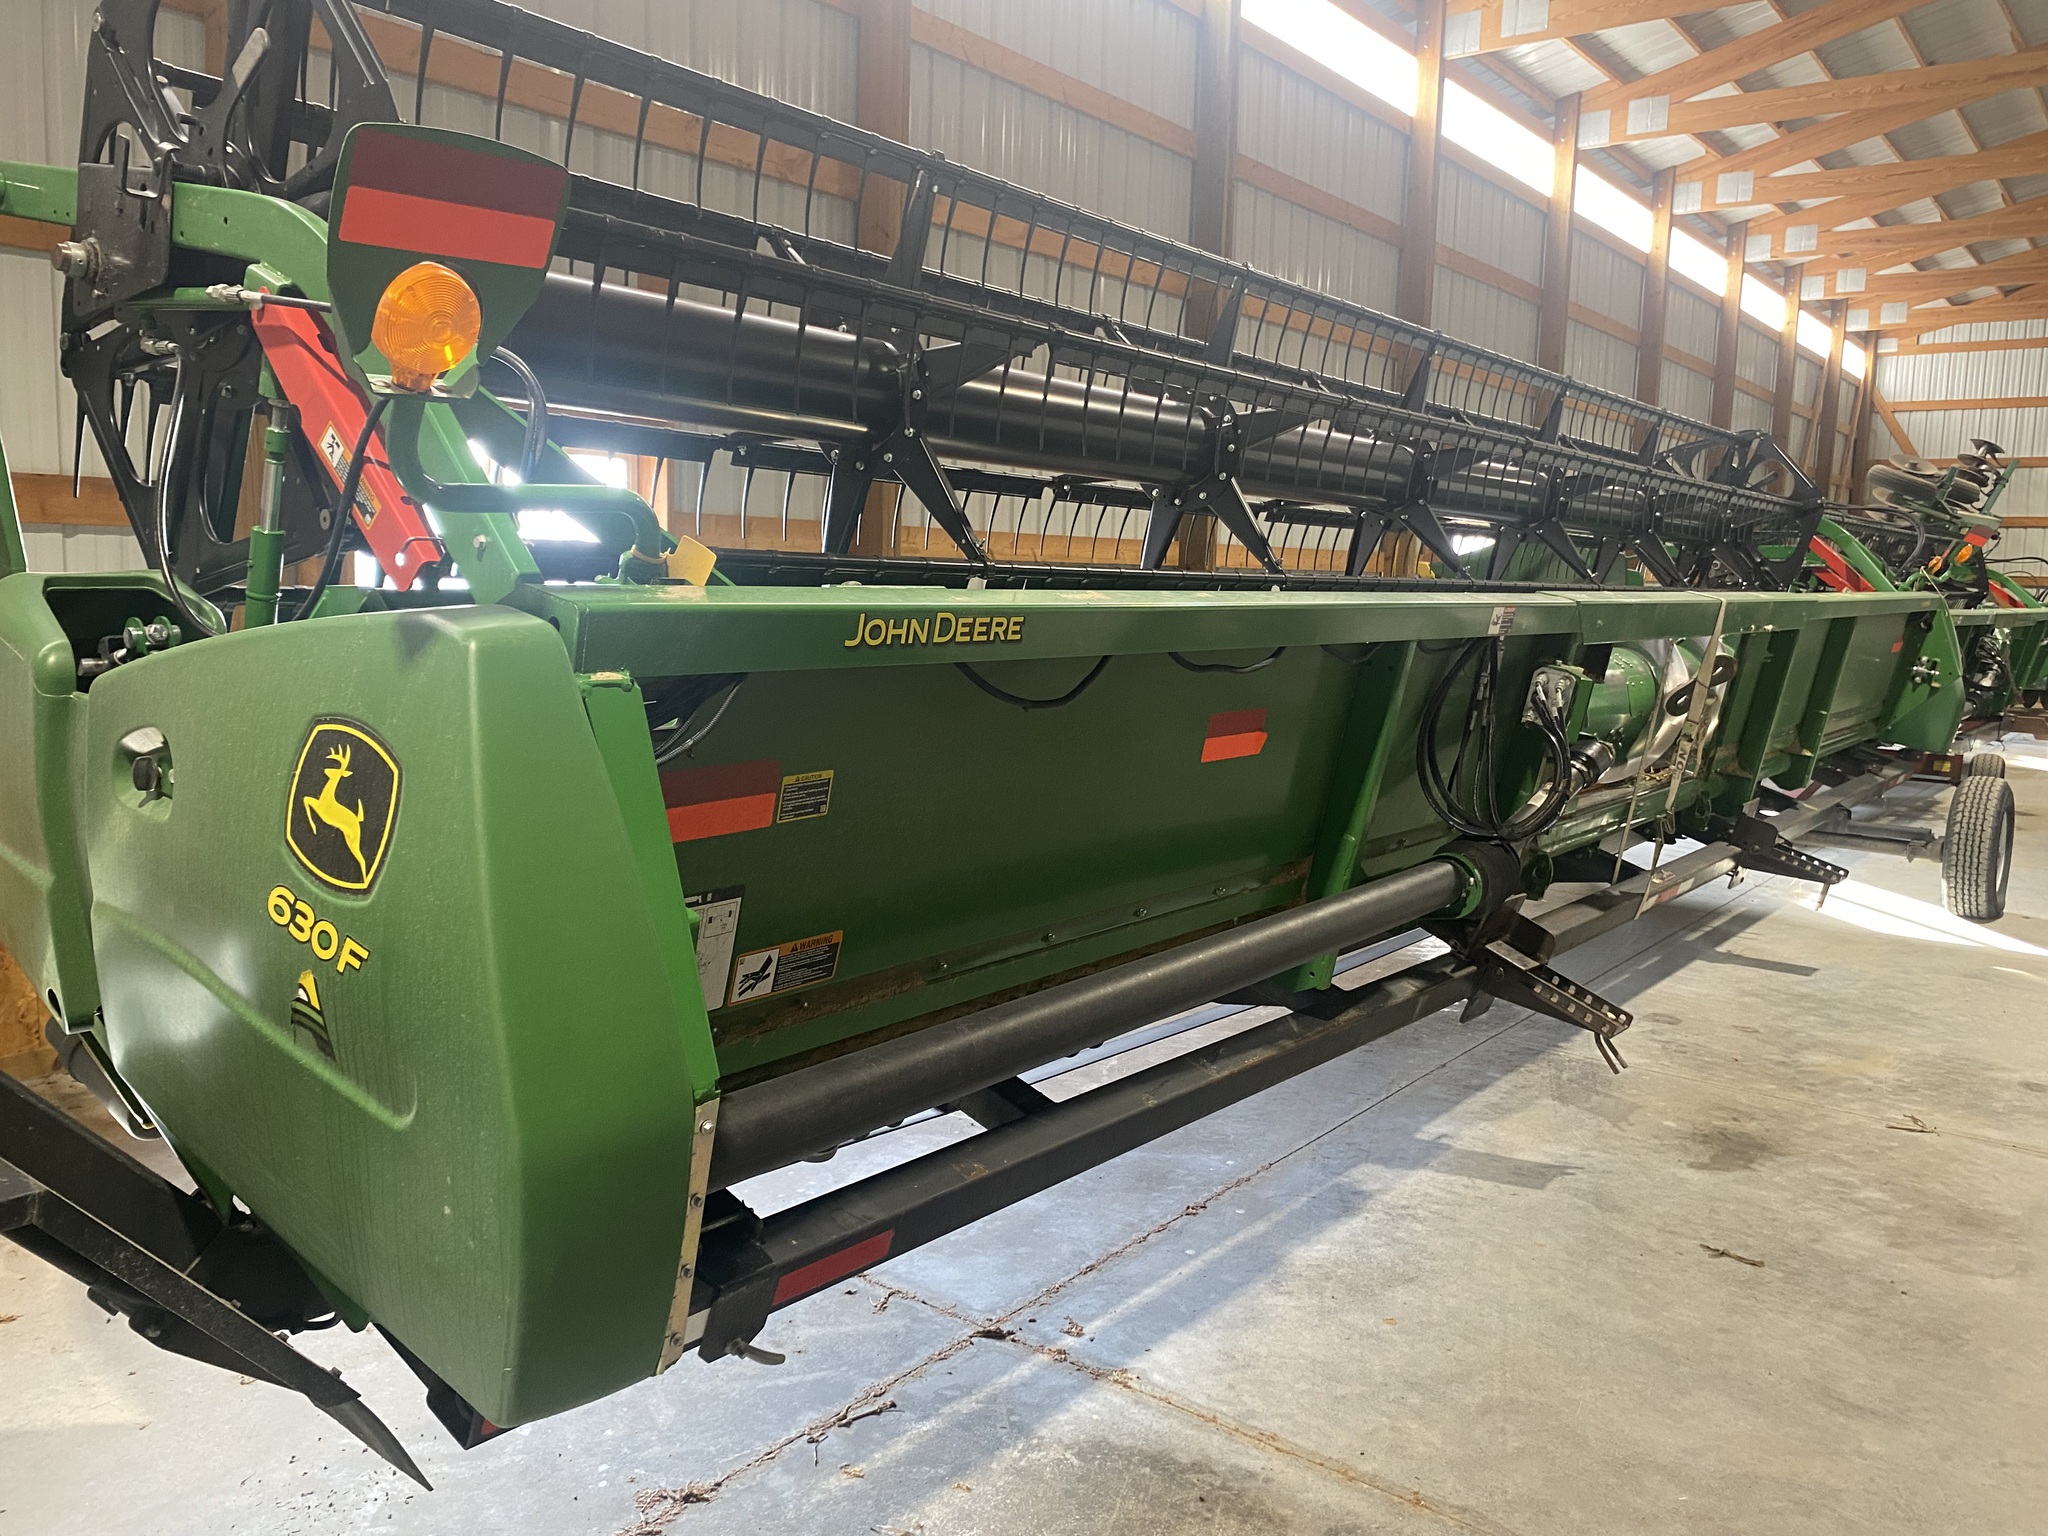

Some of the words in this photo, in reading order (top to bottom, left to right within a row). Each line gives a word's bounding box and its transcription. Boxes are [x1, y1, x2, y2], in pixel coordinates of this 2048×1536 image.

[844, 612, 930, 647] JOHN
[932, 611, 1025, 643] DEERE
[800, 773, 823, 782] CAUTION
[267, 885, 370, 975] 630F
[799, 934, 834, 950] WARNING
